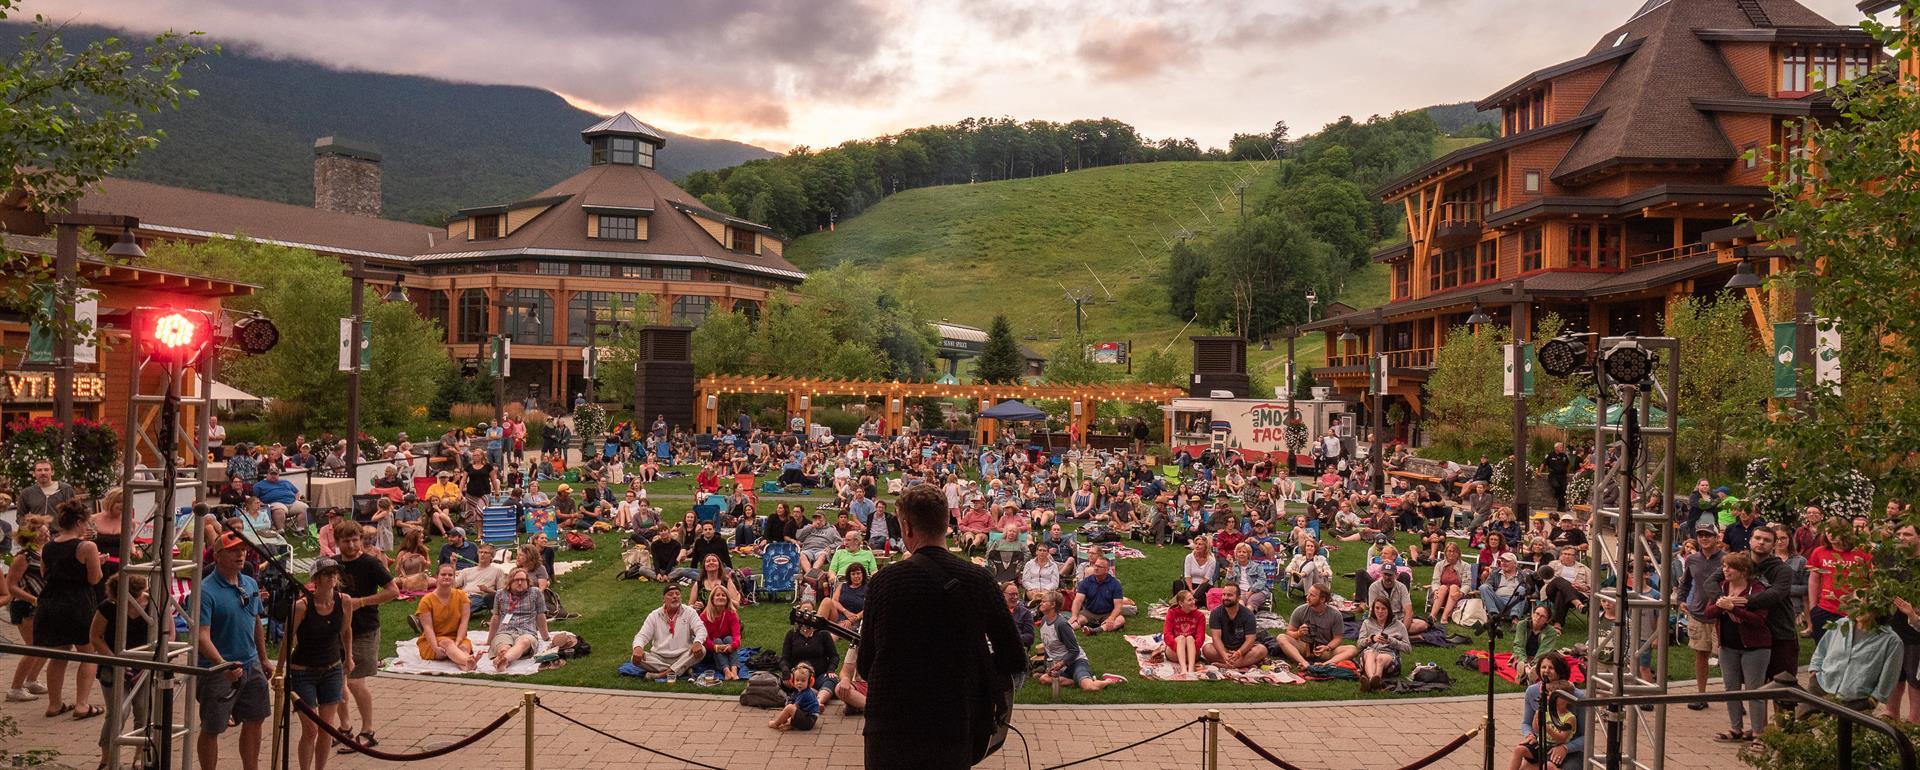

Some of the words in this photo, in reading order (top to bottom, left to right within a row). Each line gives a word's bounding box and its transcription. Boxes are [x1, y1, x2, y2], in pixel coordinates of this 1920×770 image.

[9, 376, 42, 397] VT
[1252, 410, 1260, 428] OLD
[1252, 428, 1284, 443] TAC
